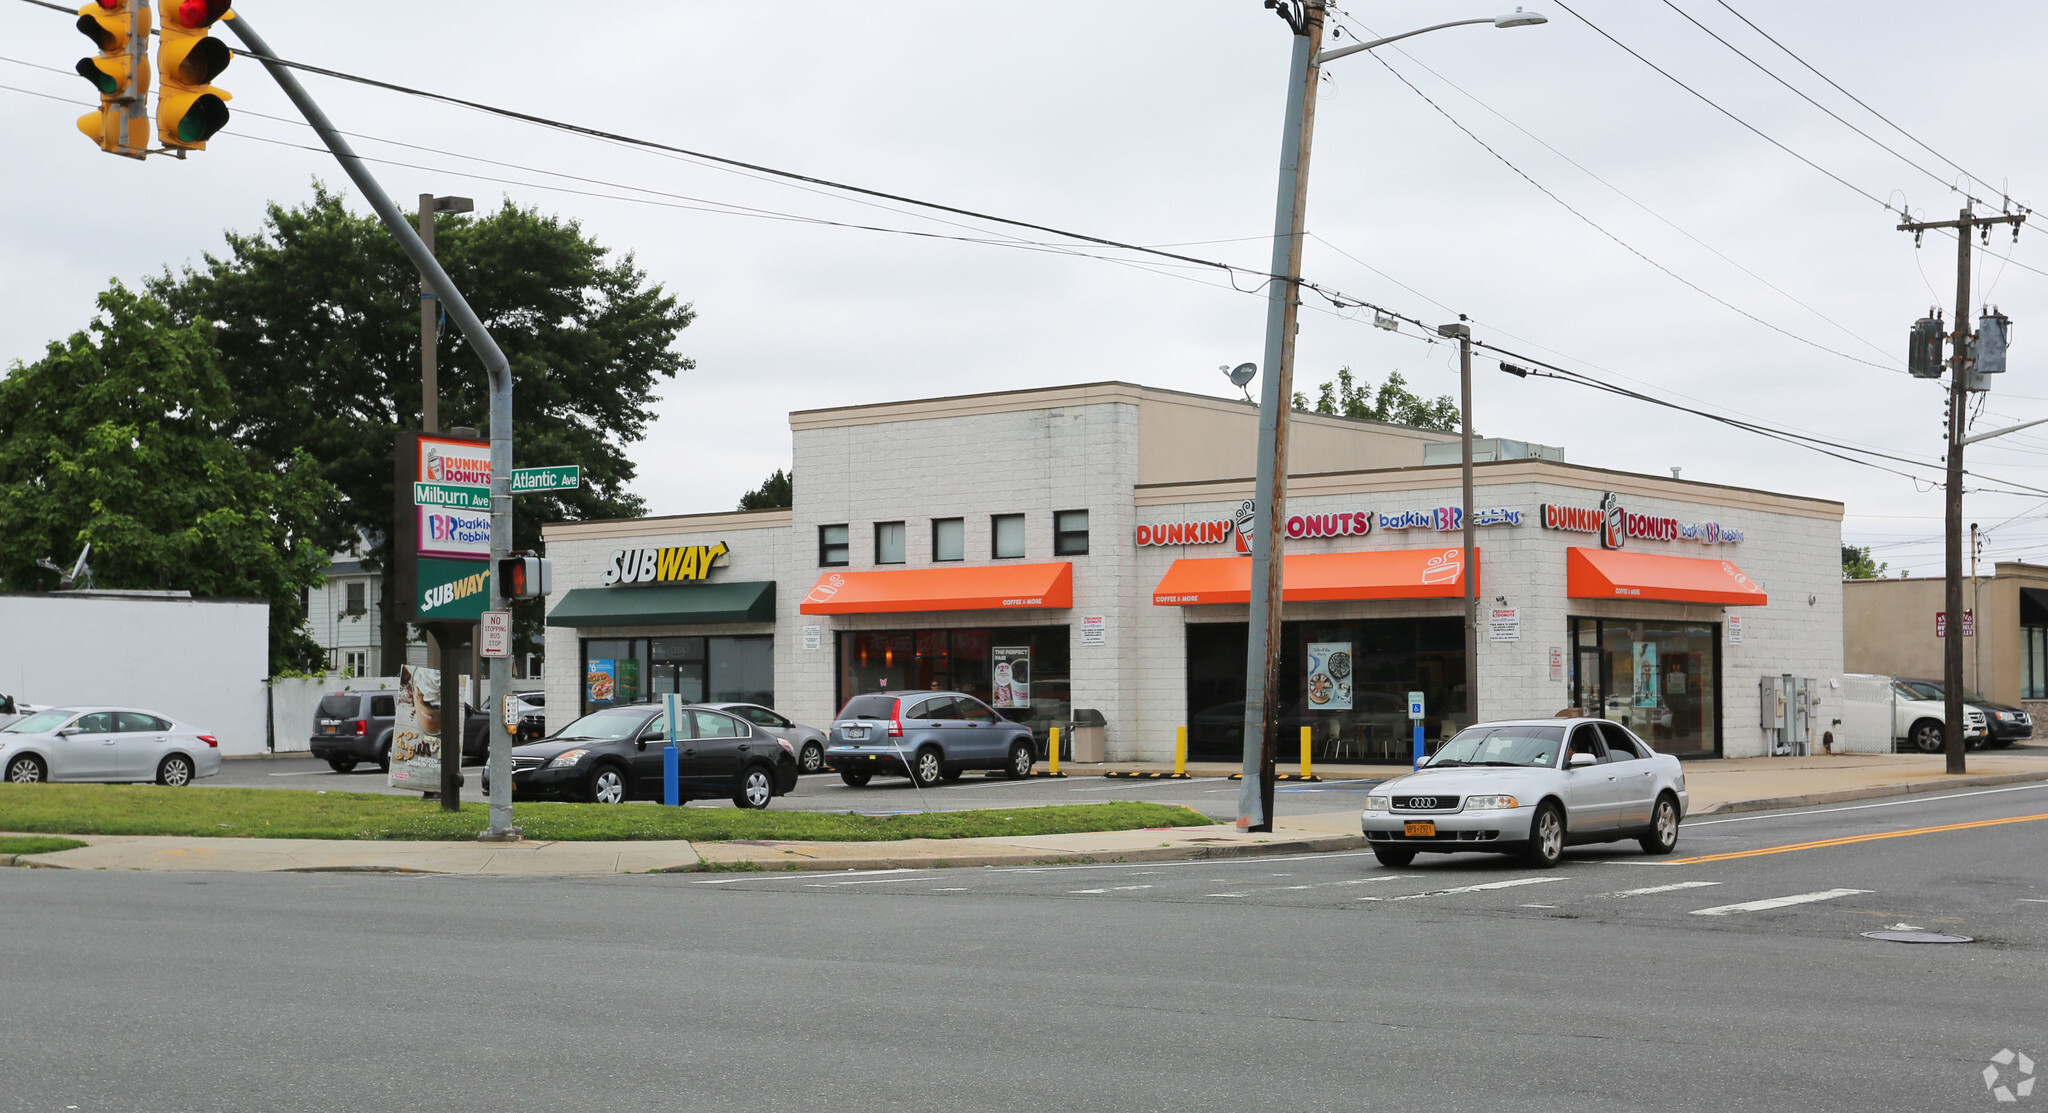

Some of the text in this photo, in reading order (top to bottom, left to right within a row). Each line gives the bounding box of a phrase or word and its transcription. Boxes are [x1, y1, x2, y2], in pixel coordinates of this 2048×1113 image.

[446, 456, 491, 472] DUNKIN
[446, 470, 491, 485] DONUTS
[512, 471, 577, 489] Atlantic Ave
[417, 485, 489, 506] Milburn Ave
[429, 514, 458, 541] BR
[1136, 511, 1368, 546] DUNKIN' ONUTS
[1379, 510, 1430, 528] baskin
[1433, 506, 1463, 530] BR
[1547, 504, 1678, 541] DUNKIN' DONUTS
[459, 531, 491, 542] robbin
[1681, 521, 1744, 543] baskin BR robbins
[601, 540, 730, 586] SUBWAY
[421, 569, 490, 612] SUBWAY
[490, 616, 501, 625] NO
